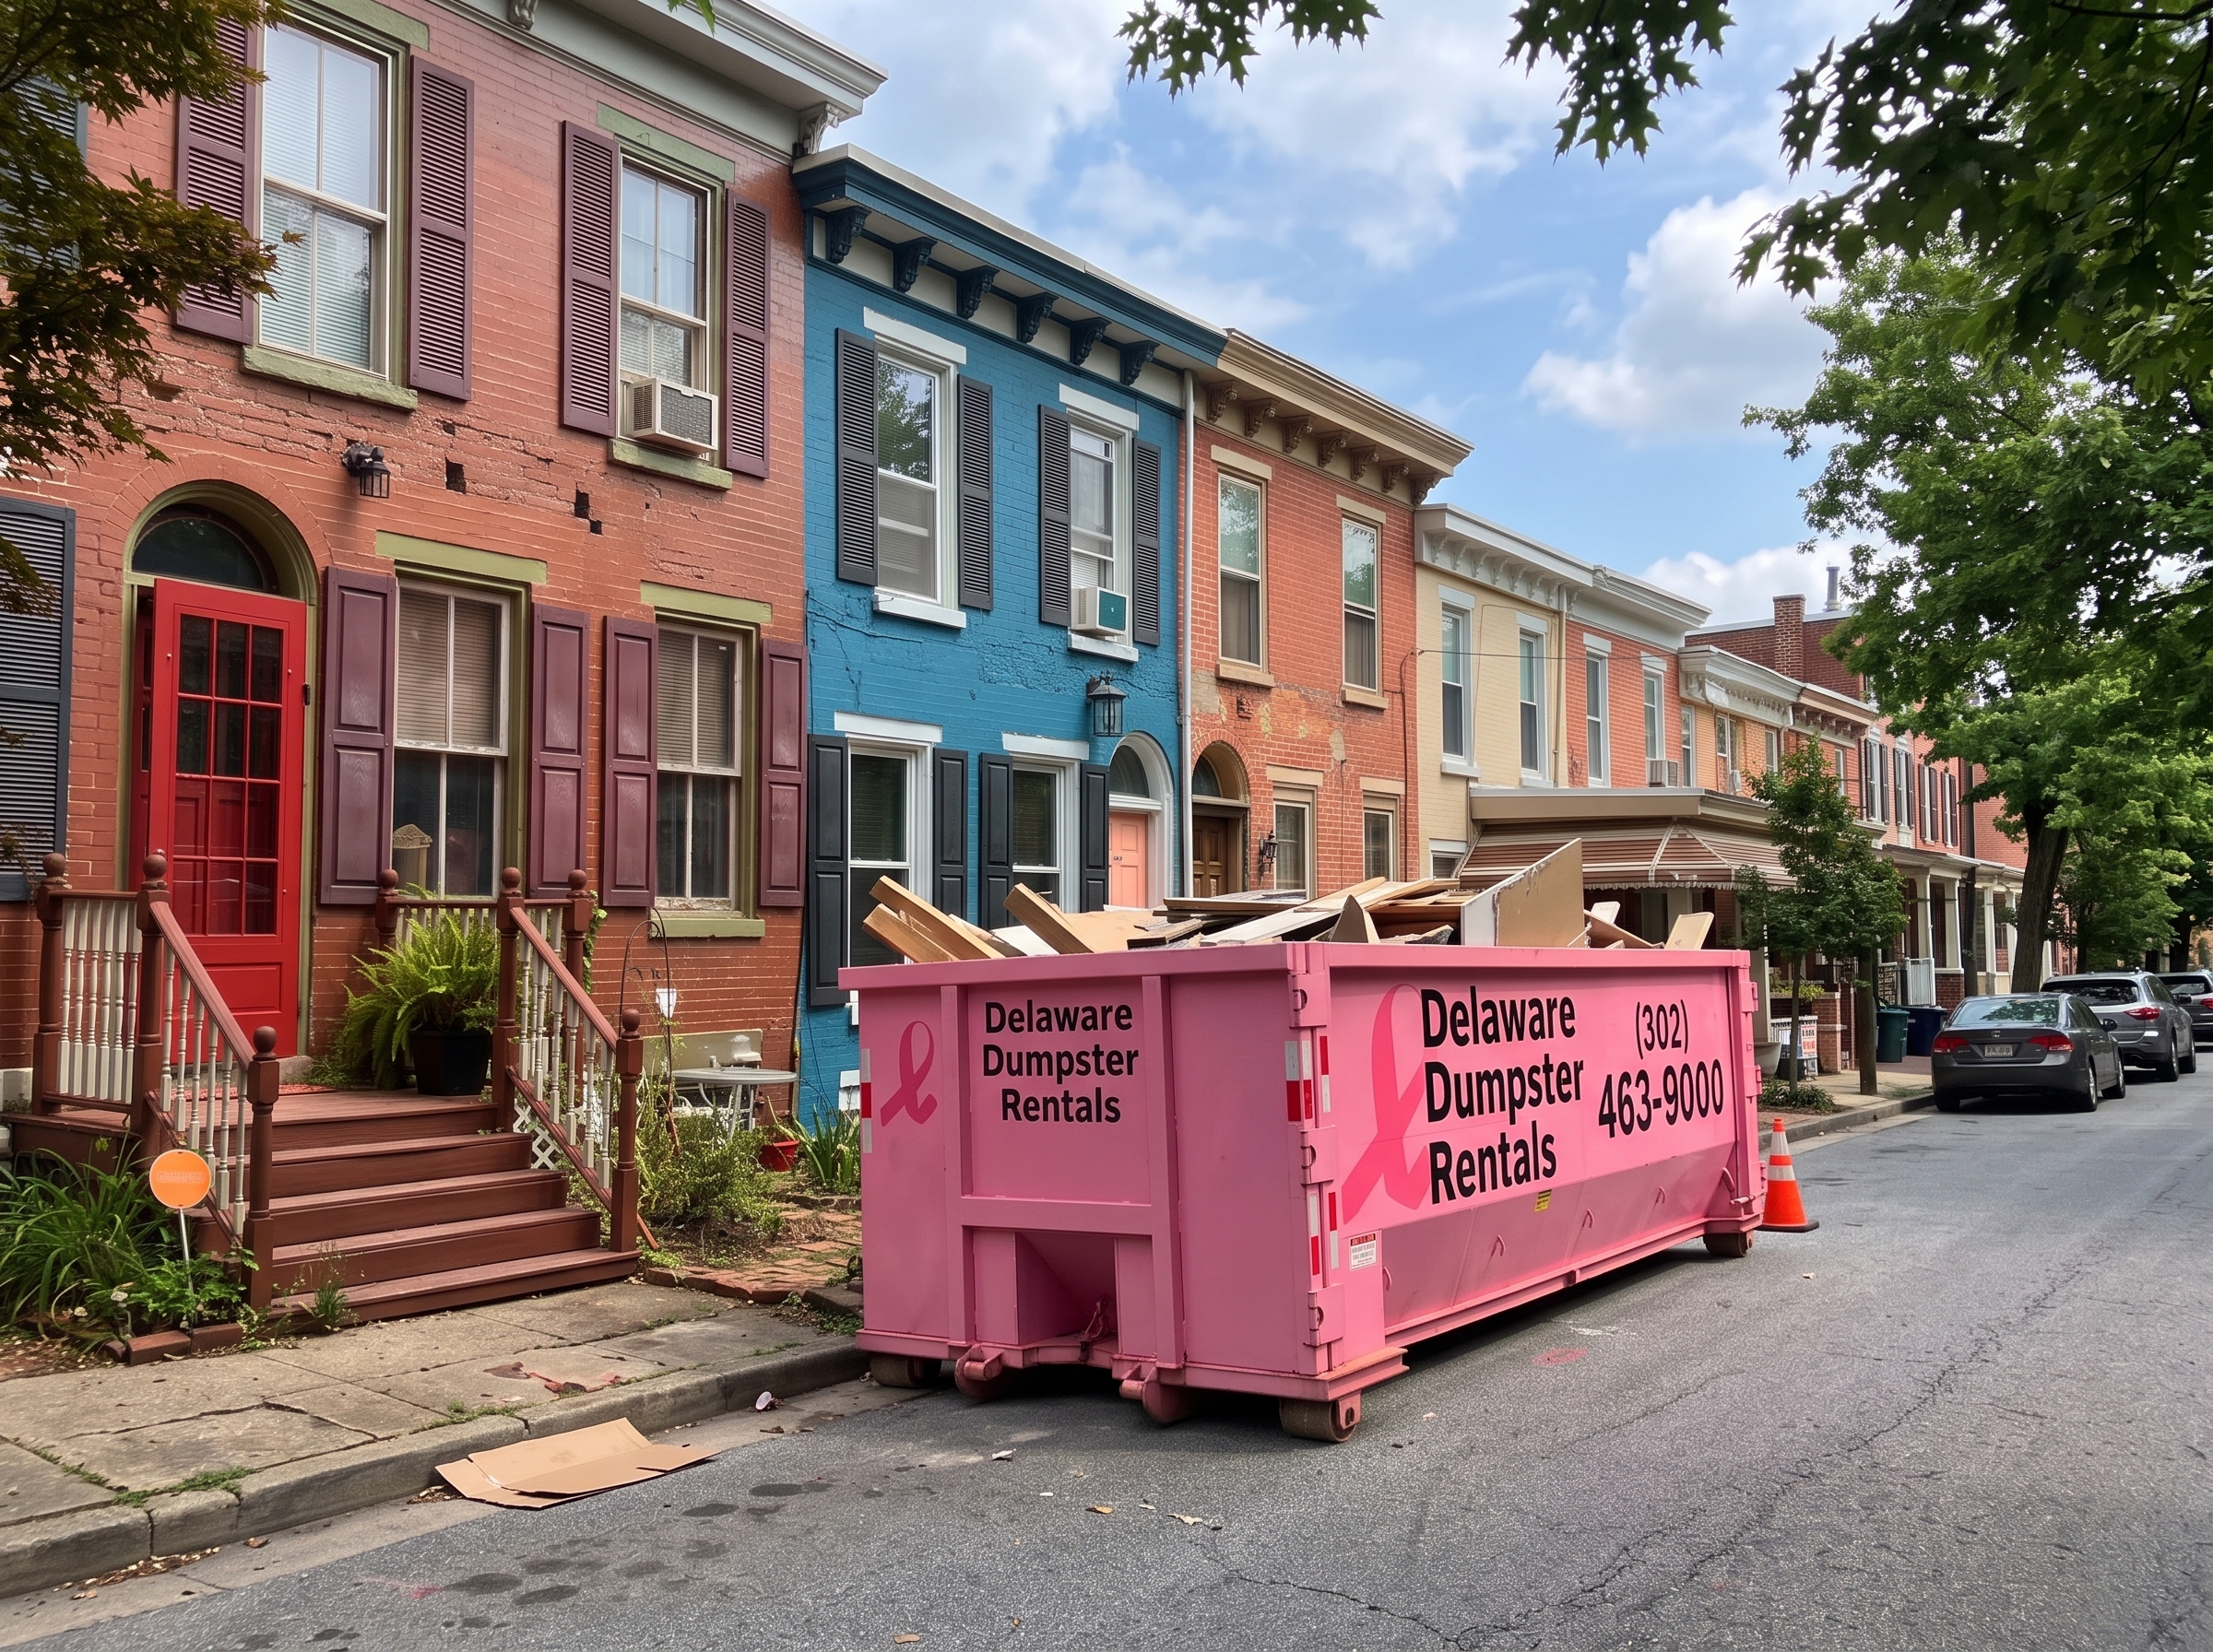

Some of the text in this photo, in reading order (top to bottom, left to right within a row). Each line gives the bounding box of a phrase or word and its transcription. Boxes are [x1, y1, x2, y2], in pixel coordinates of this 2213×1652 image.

[985, 999, 1133, 1033] Delaware
[1420, 985, 1576, 1048] Delaware
[1636, 999, 1688, 1060] (302)
[983, 1044, 1140, 1085] Dumpster
[1425, 1053, 1584, 1126] Dumpster
[1001, 1087, 1121, 1123] Rentals
[1598, 1059, 1723, 1139] 463-9000
[1429, 1120, 1557, 1205] Rentals
